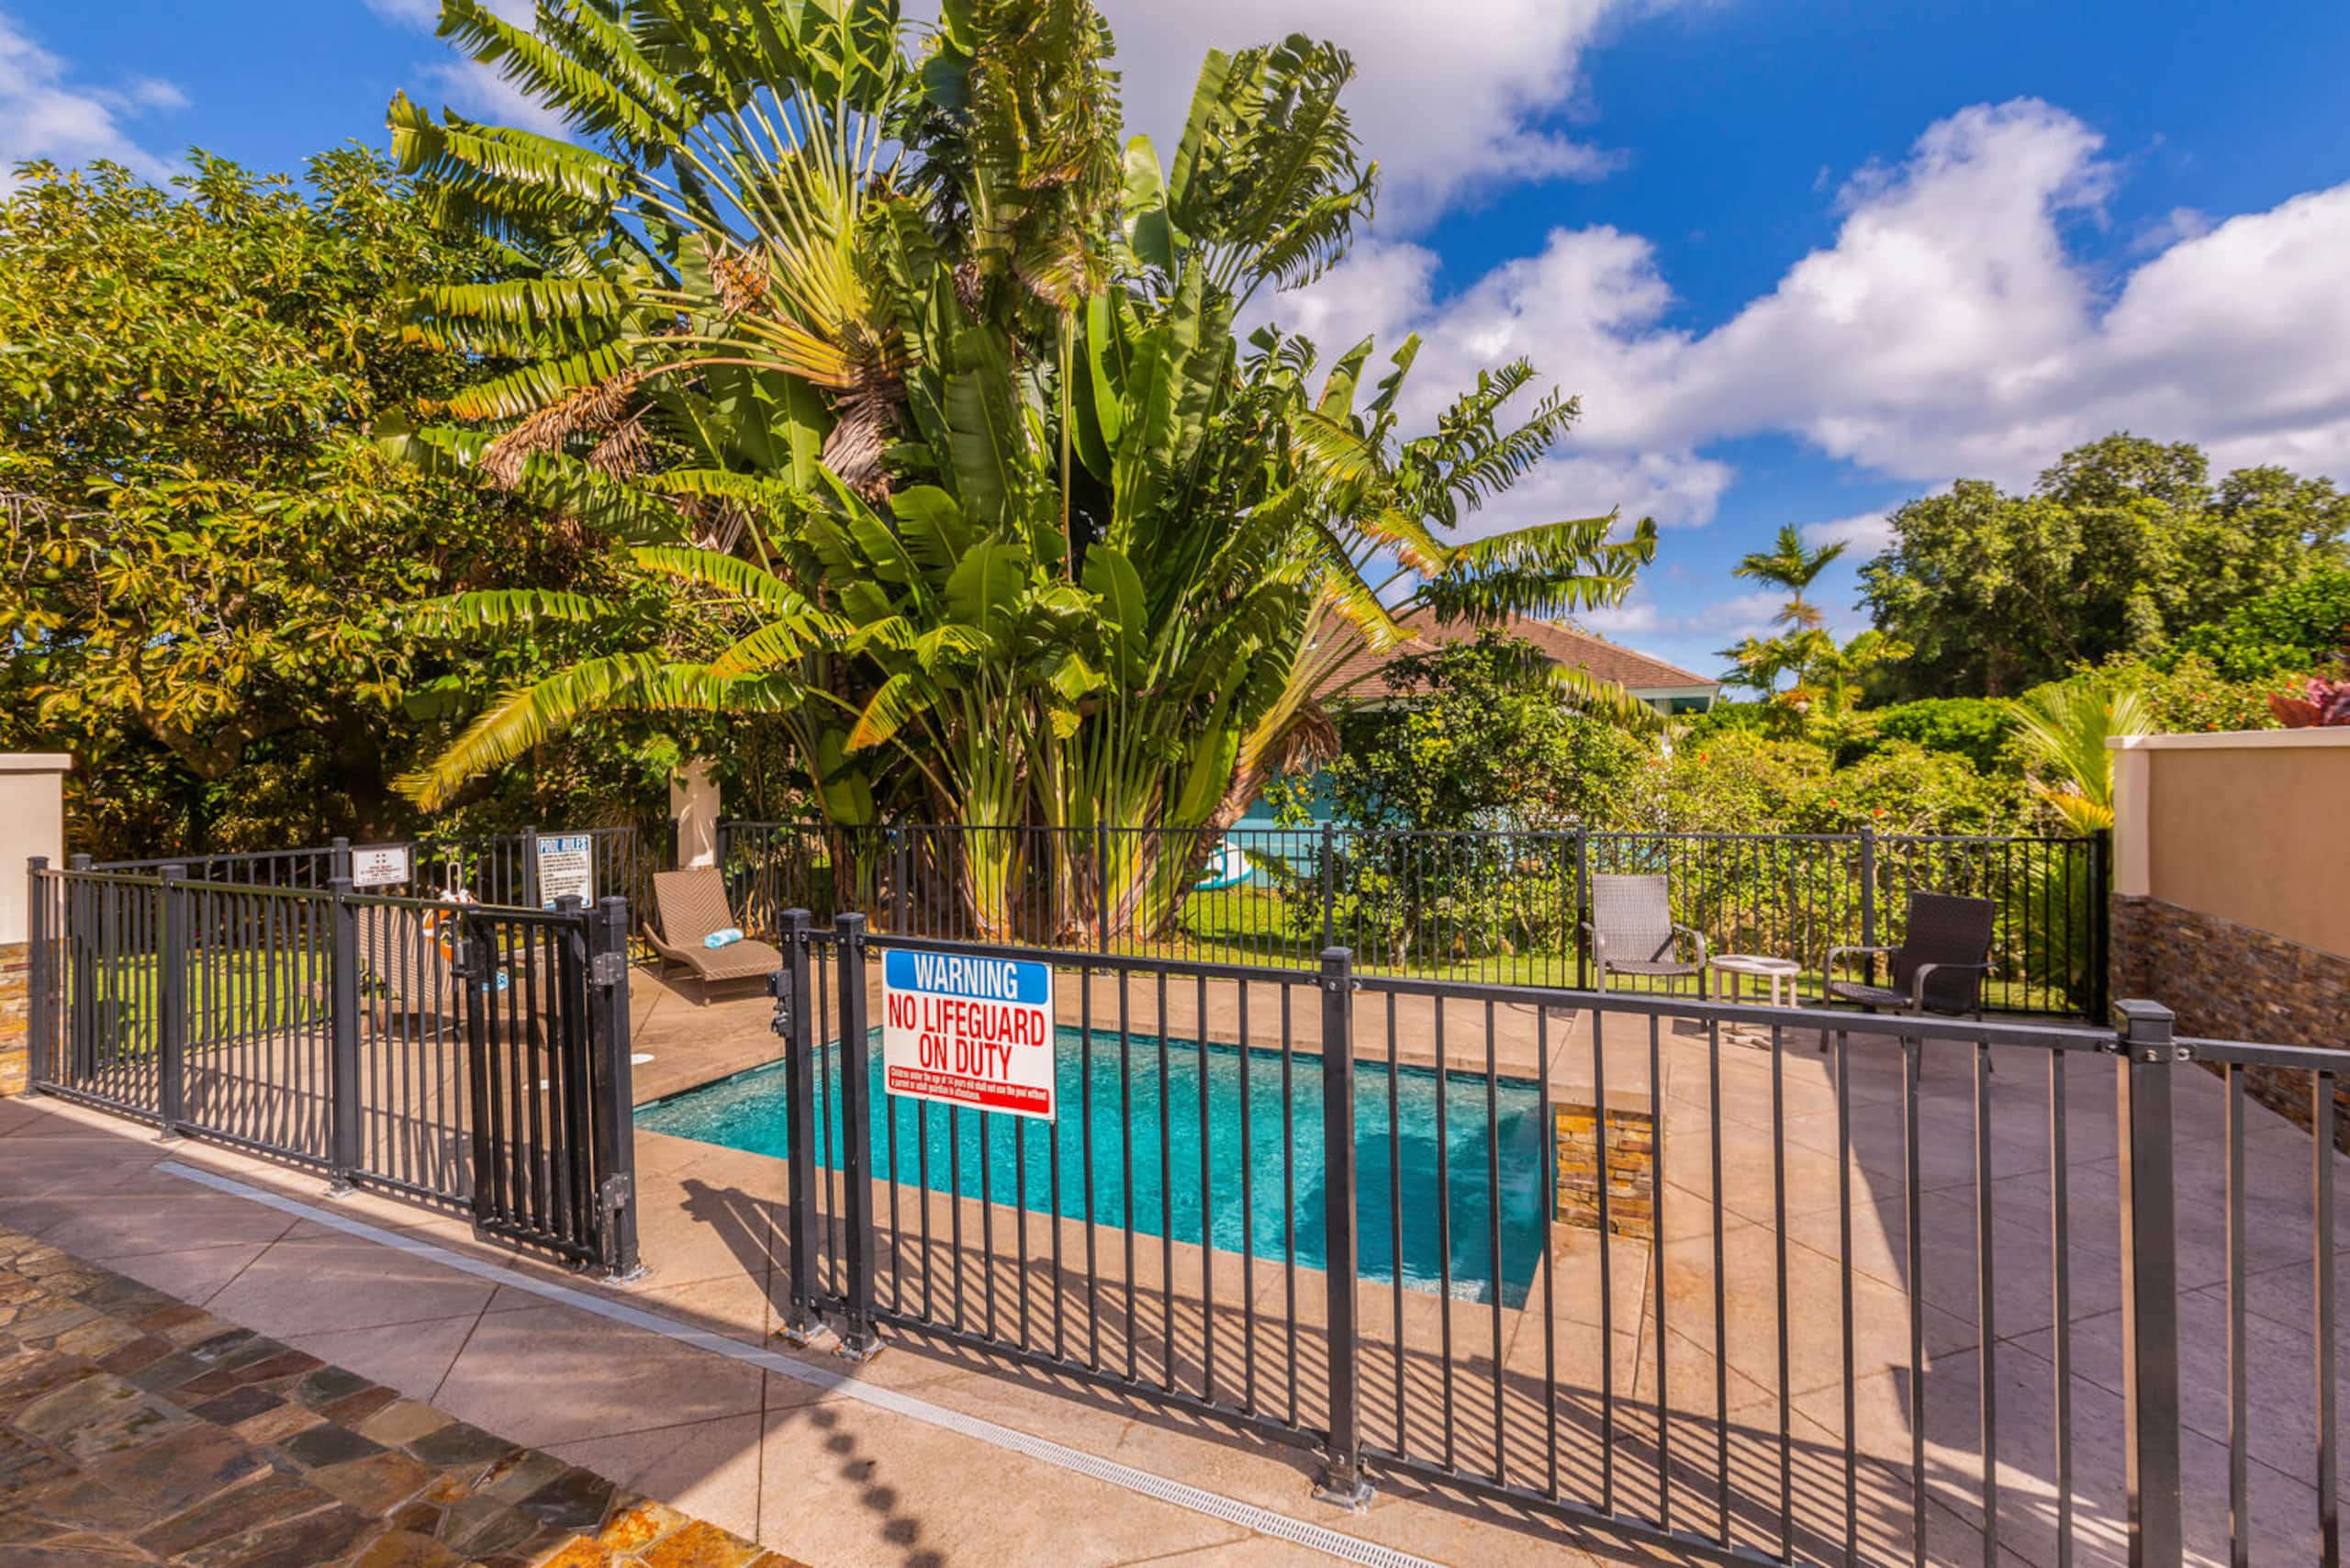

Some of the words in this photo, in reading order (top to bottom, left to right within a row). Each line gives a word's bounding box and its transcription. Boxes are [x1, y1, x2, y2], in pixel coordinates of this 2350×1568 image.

[914, 954, 1018, 999] WARNING
[889, 993, 916, 1030] NO
[923, 997, 1045, 1047] LIFEGUARD
[919, 1034, 946, 1070] ON
[956, 1038, 1012, 1080] DUTY
